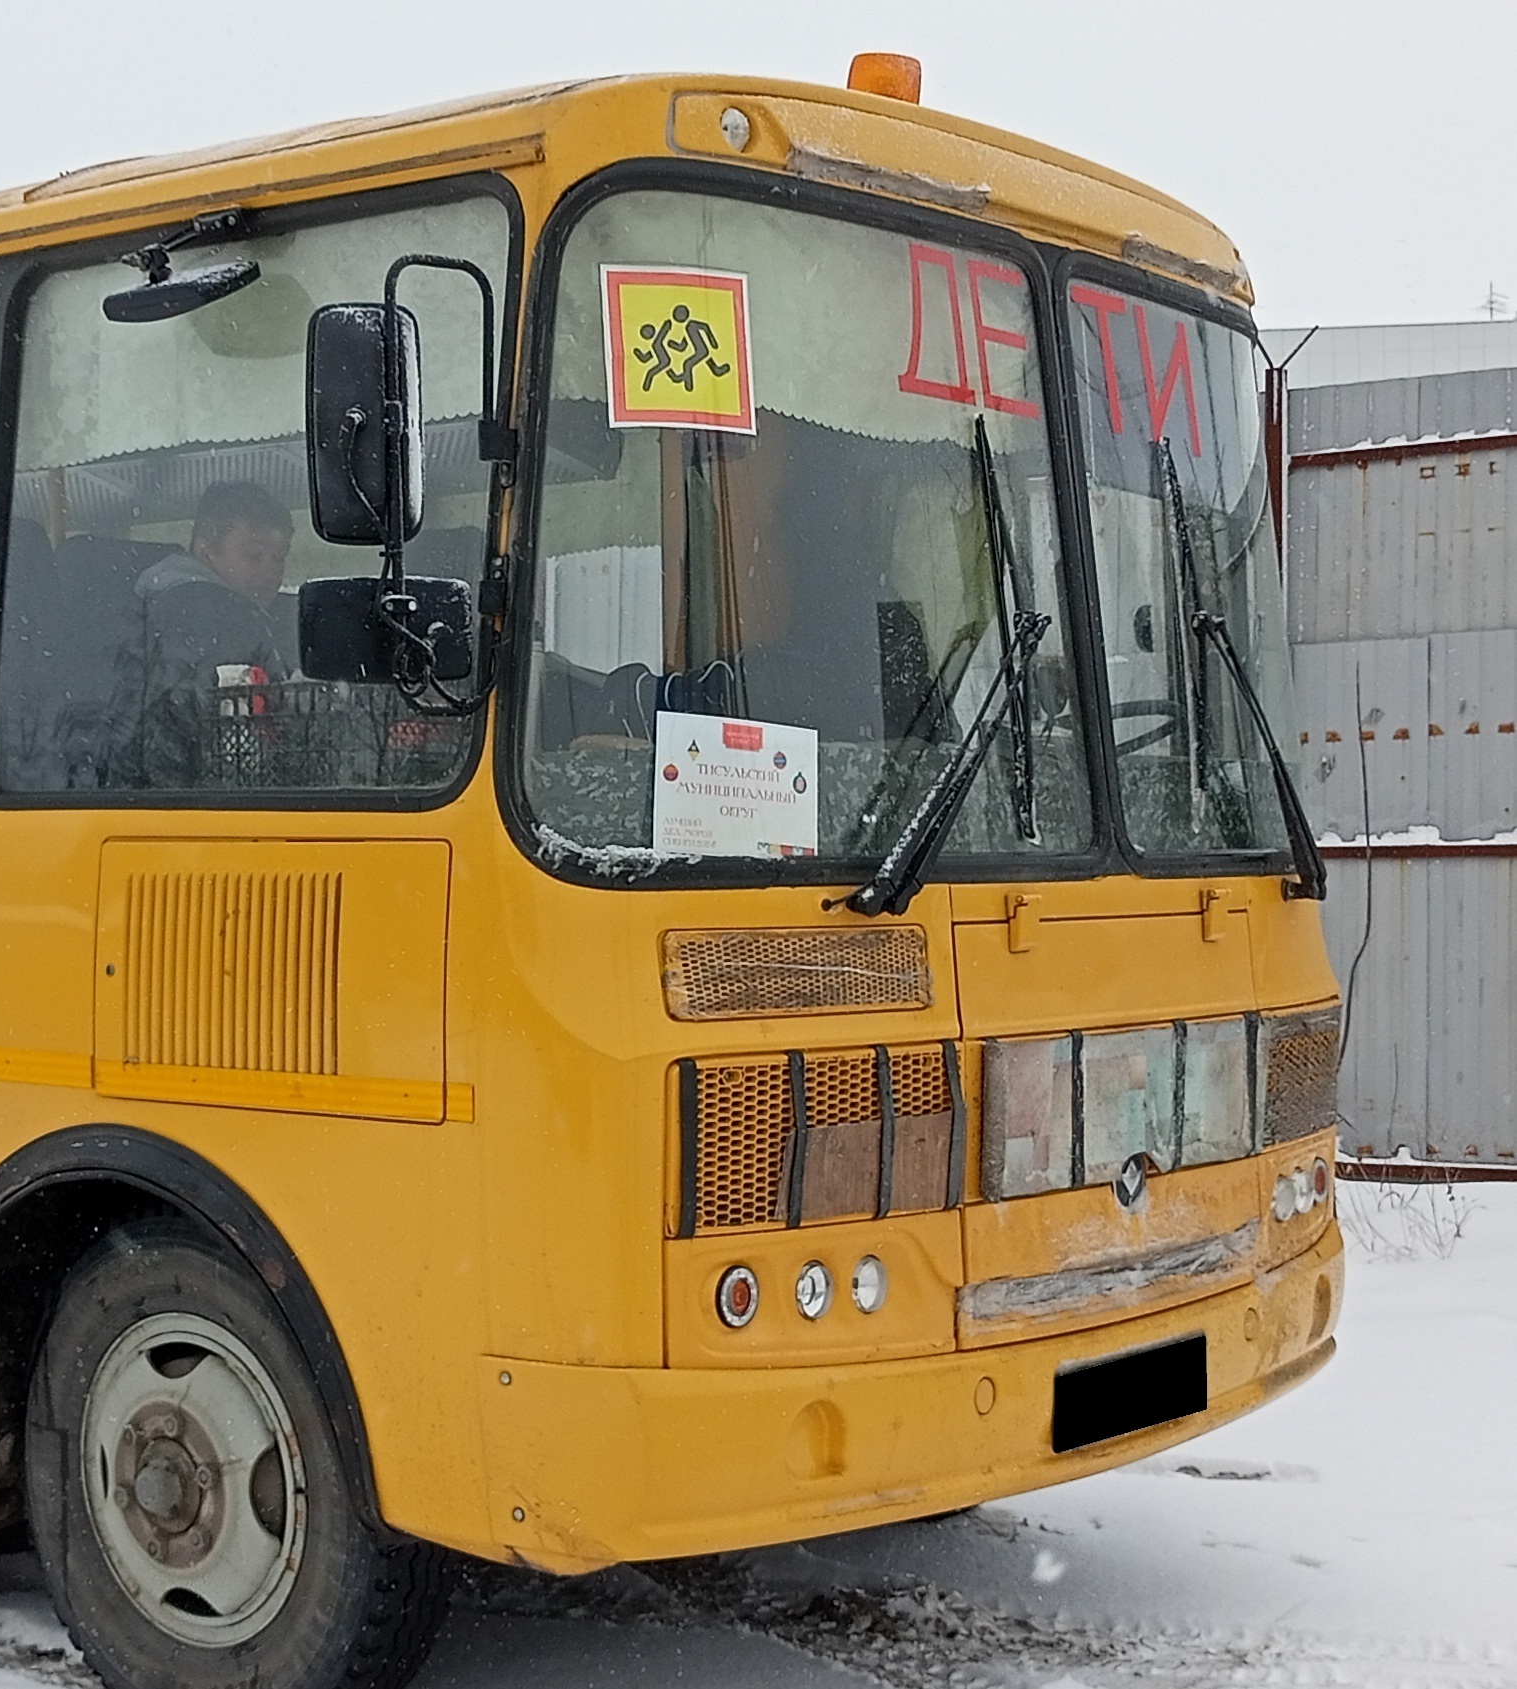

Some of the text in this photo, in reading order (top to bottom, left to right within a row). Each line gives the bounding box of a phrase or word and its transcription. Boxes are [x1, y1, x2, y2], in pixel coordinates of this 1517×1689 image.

[696, 763, 780, 783] ТИСУЛЬСКИЙ
[675, 781, 796, 804] МУНИЦИПАЛЬНЫЙ
[719, 805, 758, 819] ОКРУГ
